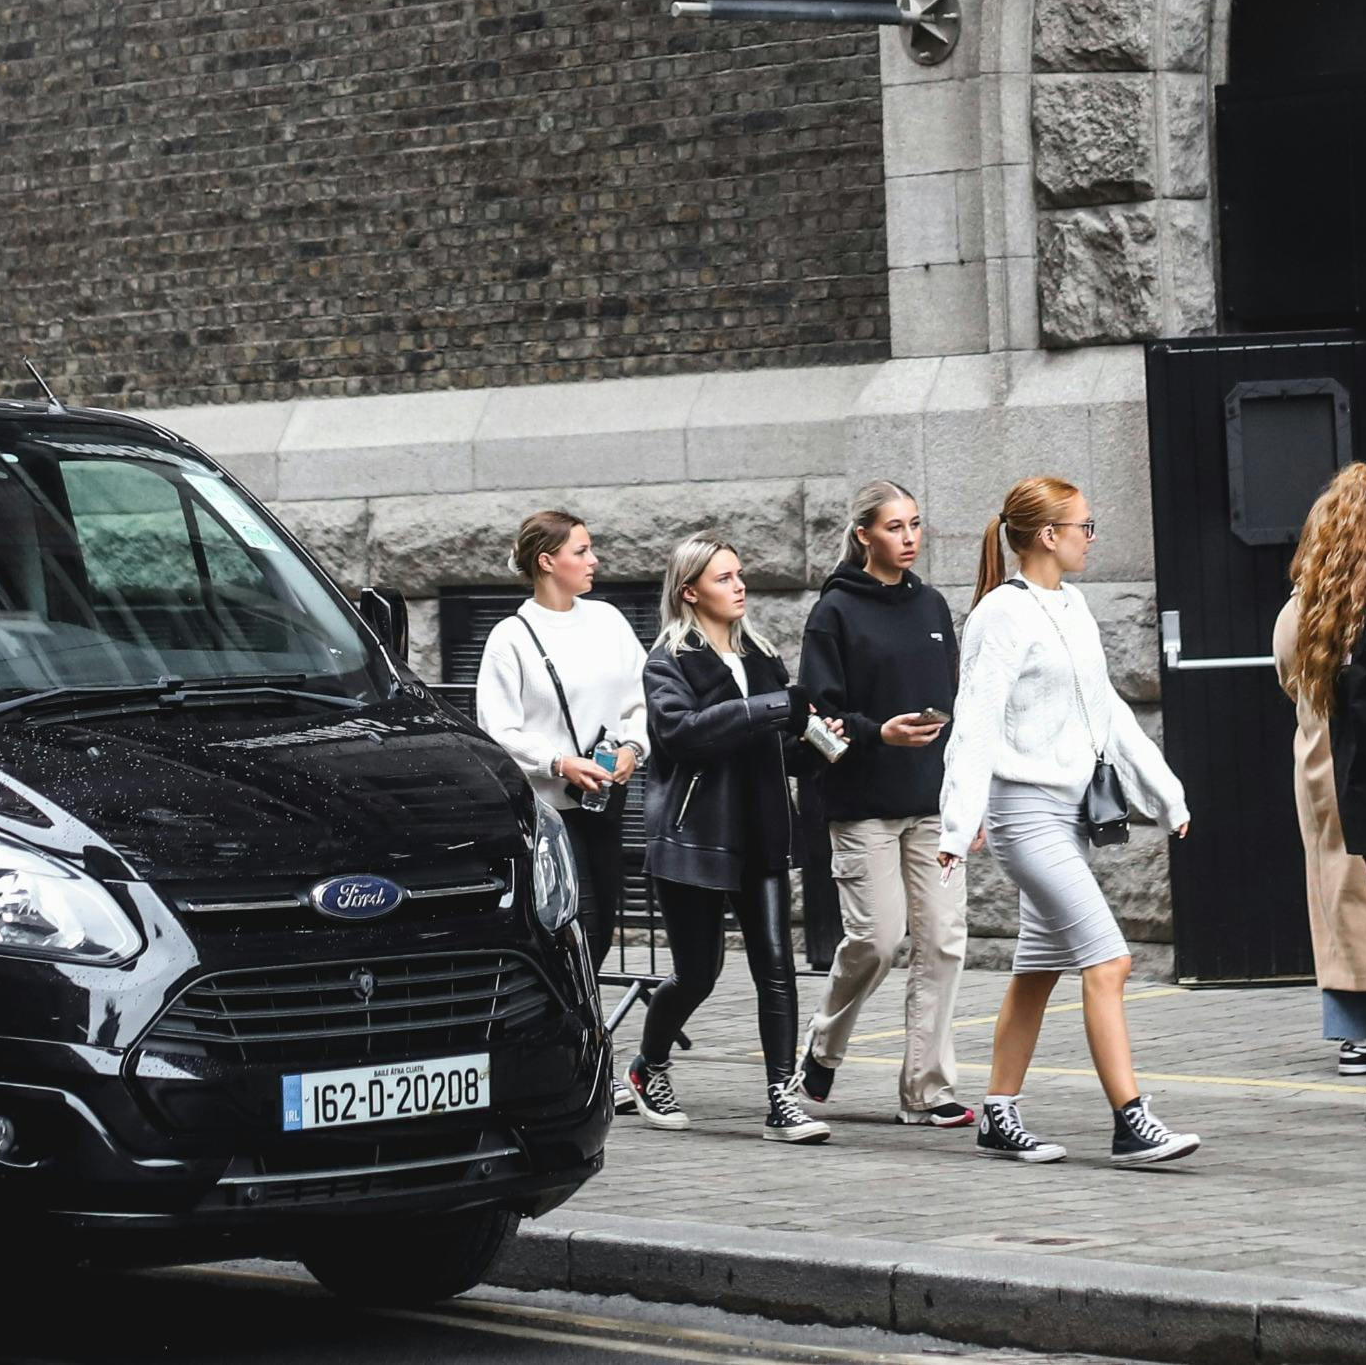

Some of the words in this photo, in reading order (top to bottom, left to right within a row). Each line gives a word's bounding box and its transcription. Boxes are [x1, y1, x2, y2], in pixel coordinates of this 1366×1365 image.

[337, 883, 385, 909] Ford
[314, 1068, 480, 1124] 162-D-20208
[285, 1110, 300, 1123] IRL
